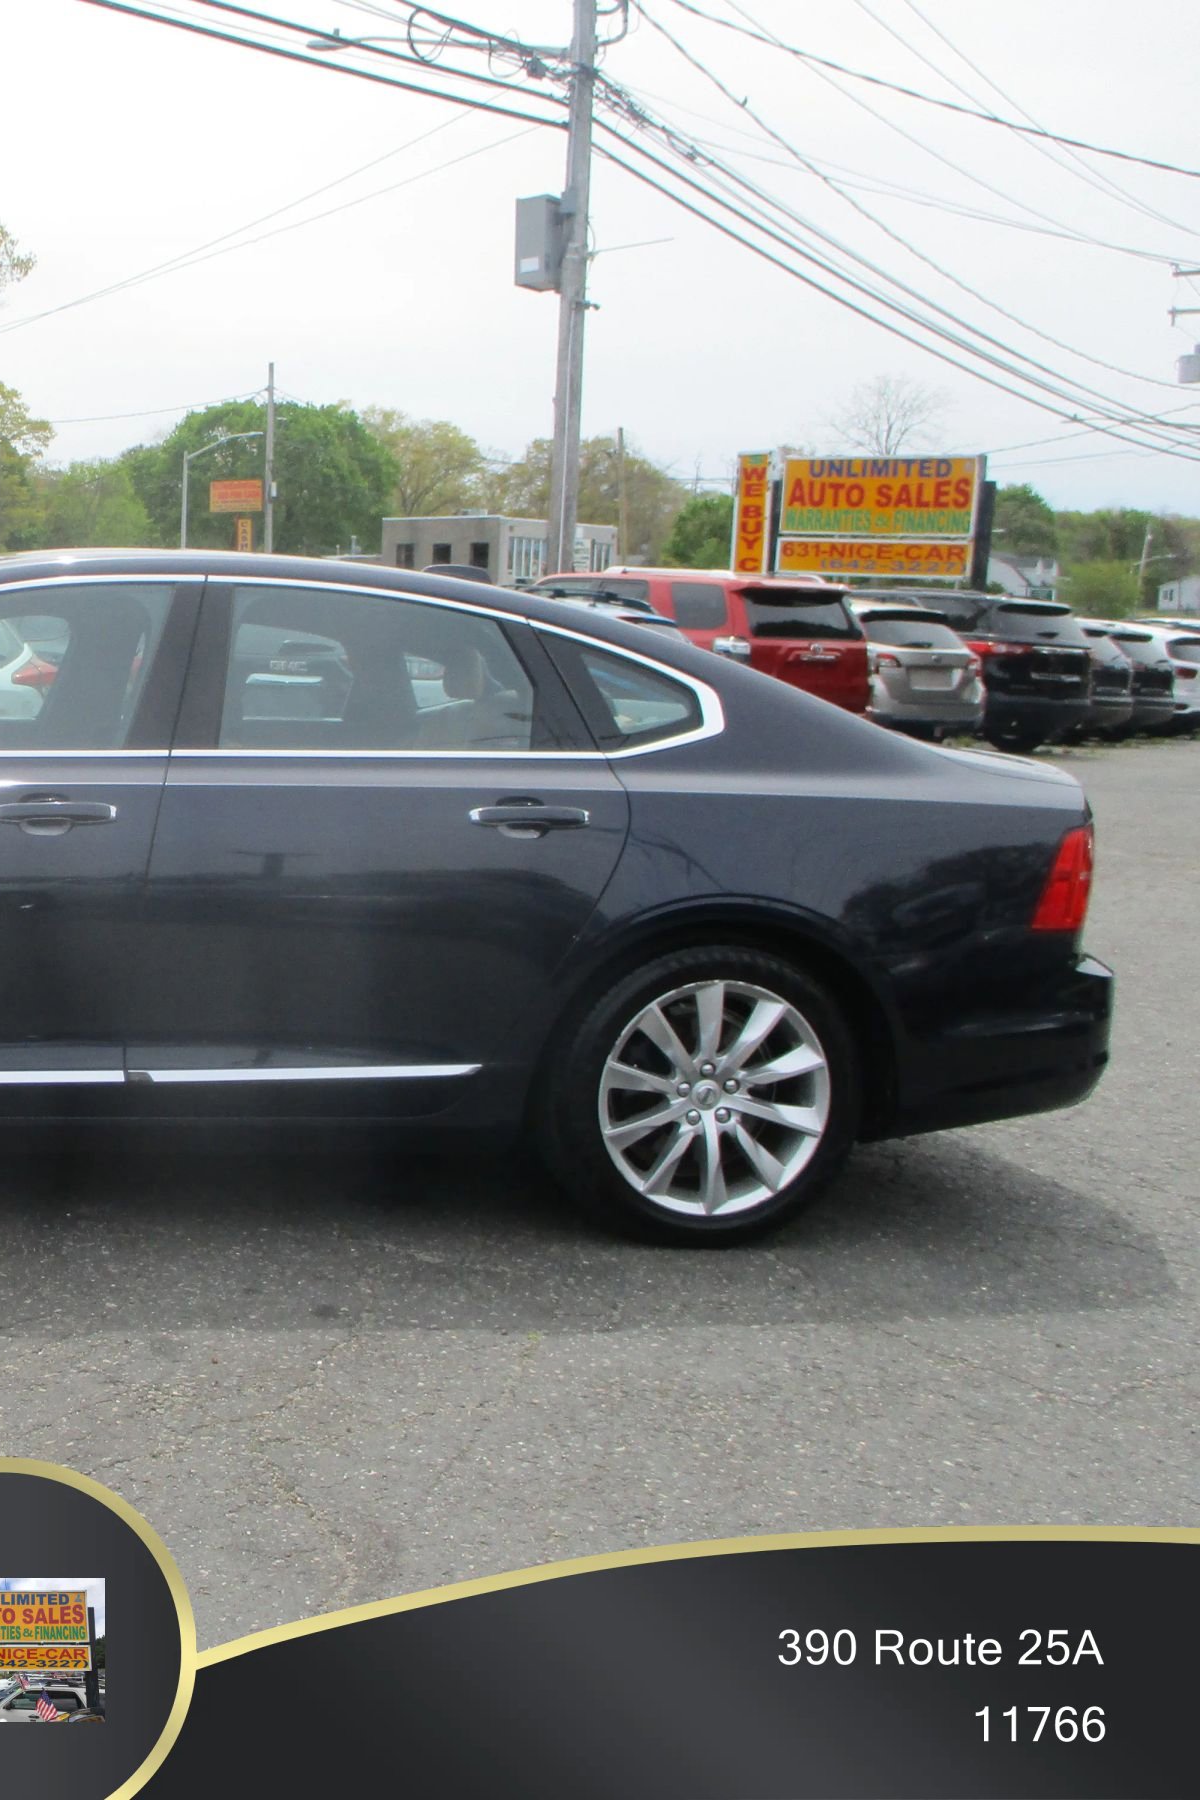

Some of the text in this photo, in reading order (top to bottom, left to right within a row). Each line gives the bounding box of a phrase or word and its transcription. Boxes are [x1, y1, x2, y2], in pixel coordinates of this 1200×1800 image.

[810, 459, 952, 478] UNLIMITED
[788, 477, 971, 509] AUTO SALES
[785, 509, 872, 531] WARRANTIES
[893, 511, 971, 534] FINANCING
[782, 543, 965, 560] 631-NICE-CAR
